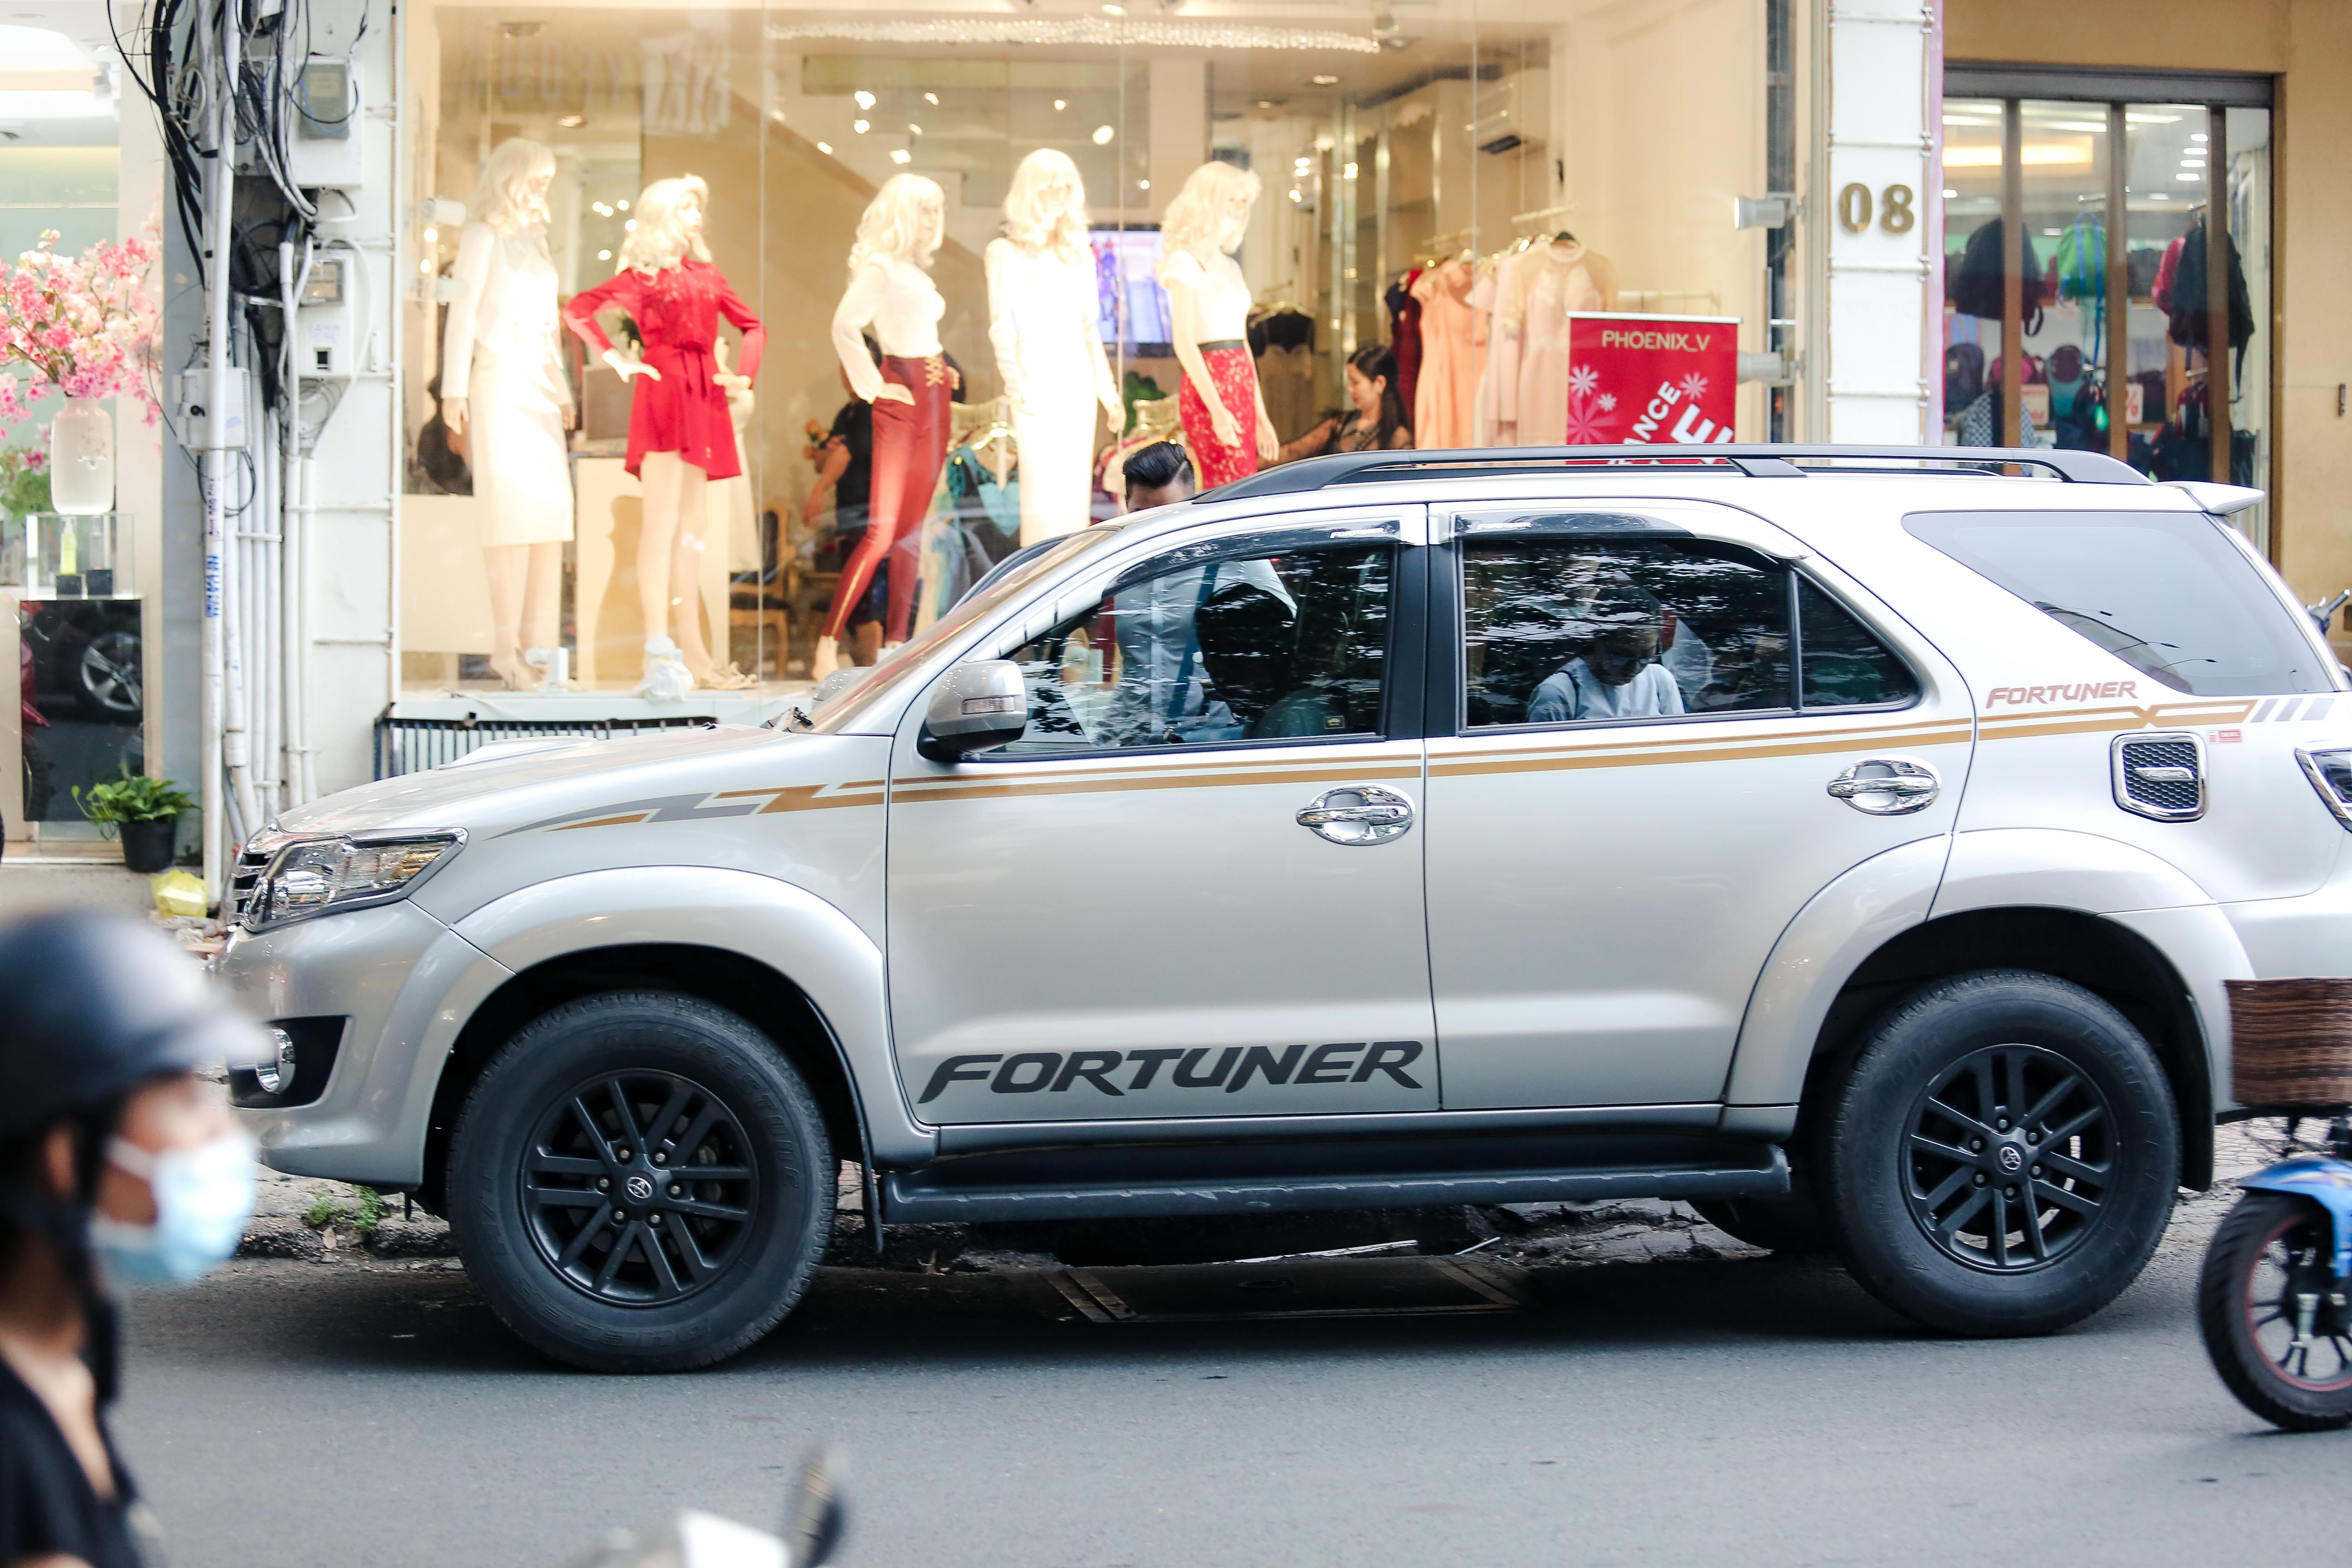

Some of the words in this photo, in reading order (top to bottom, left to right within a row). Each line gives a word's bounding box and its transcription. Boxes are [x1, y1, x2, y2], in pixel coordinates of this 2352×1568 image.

[1840, 183, 1914, 234] 08
[1601, 330, 1711, 352] PHOENIX_V
[1986, 680, 2139, 708] FORTUNER
[917, 1040, 1423, 1105] FORTUNER
